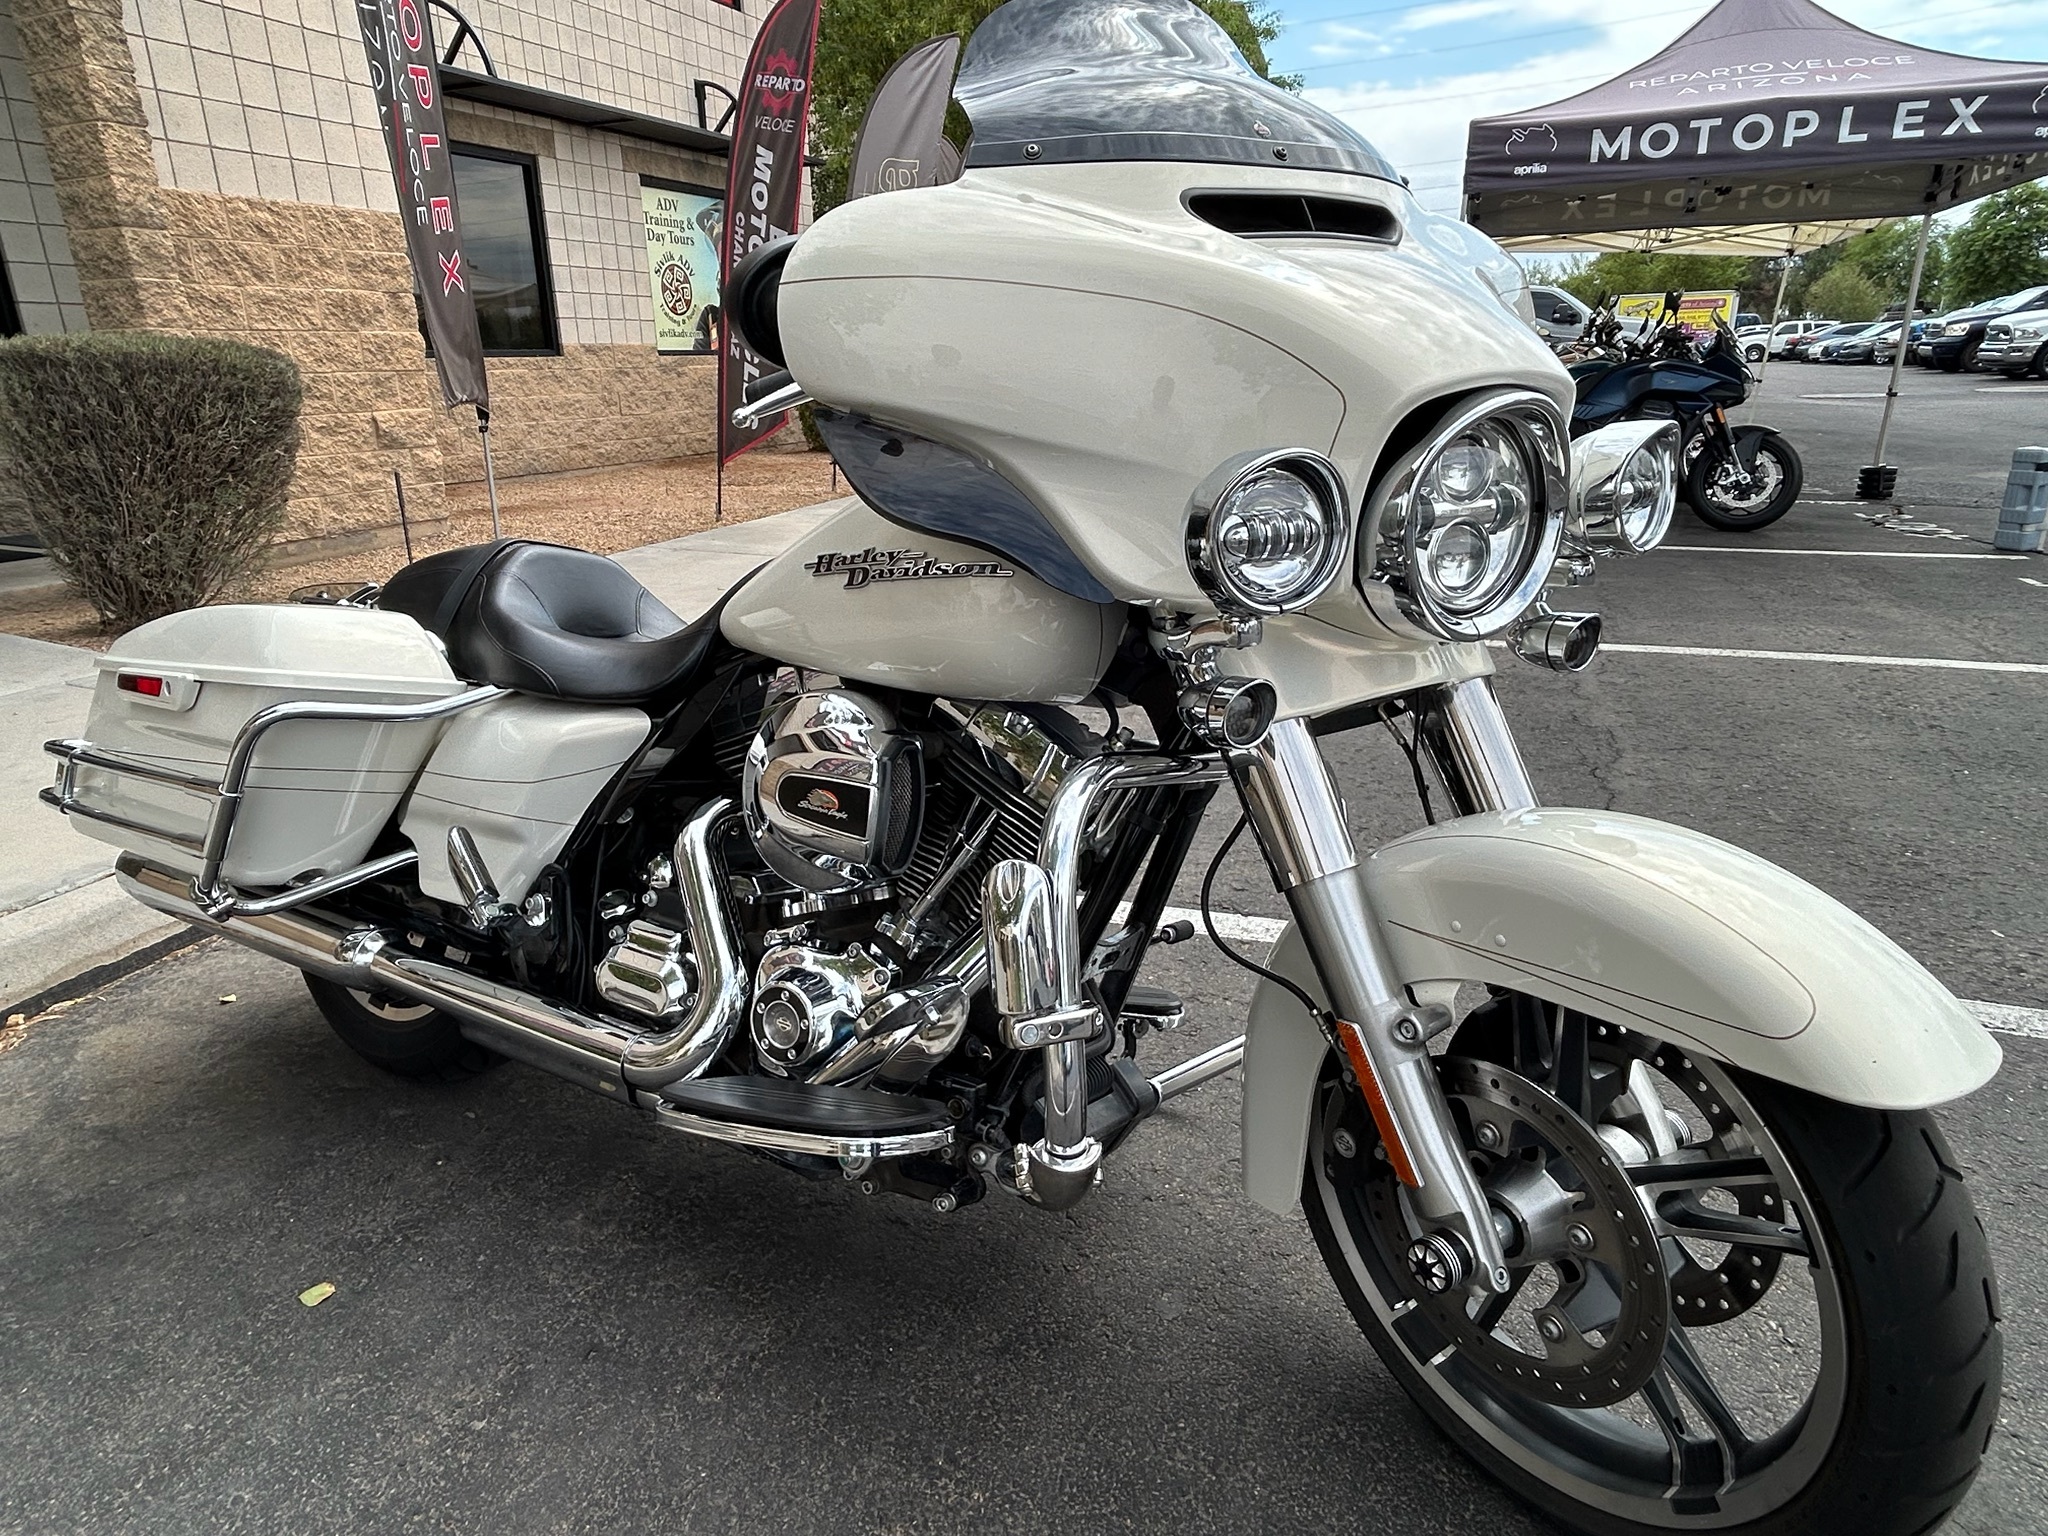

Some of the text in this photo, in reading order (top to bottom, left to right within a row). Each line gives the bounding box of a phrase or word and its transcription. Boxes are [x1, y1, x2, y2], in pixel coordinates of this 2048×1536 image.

[754, 73, 806, 92] REPARTO
[1628, 54, 1917, 89] REPARTO VELOCE
[1675, 72, 1873, 97] ARIZONA
[754, 115, 796, 133] VELOCE
[1589, 94, 1990, 163] MOTOPLEX
[398, 73, 429, 226] VELOCE
[1513, 162, 1548, 176] aprilia
[656, 197, 679, 213] ADV
[643, 211, 695, 233] Training &
[646, 228, 695, 246] Day Tours
[654, 250, 675, 278] Sivlik
[804, 547, 927, 577] Harley
[836, 557, 1015, 590] Davidson
